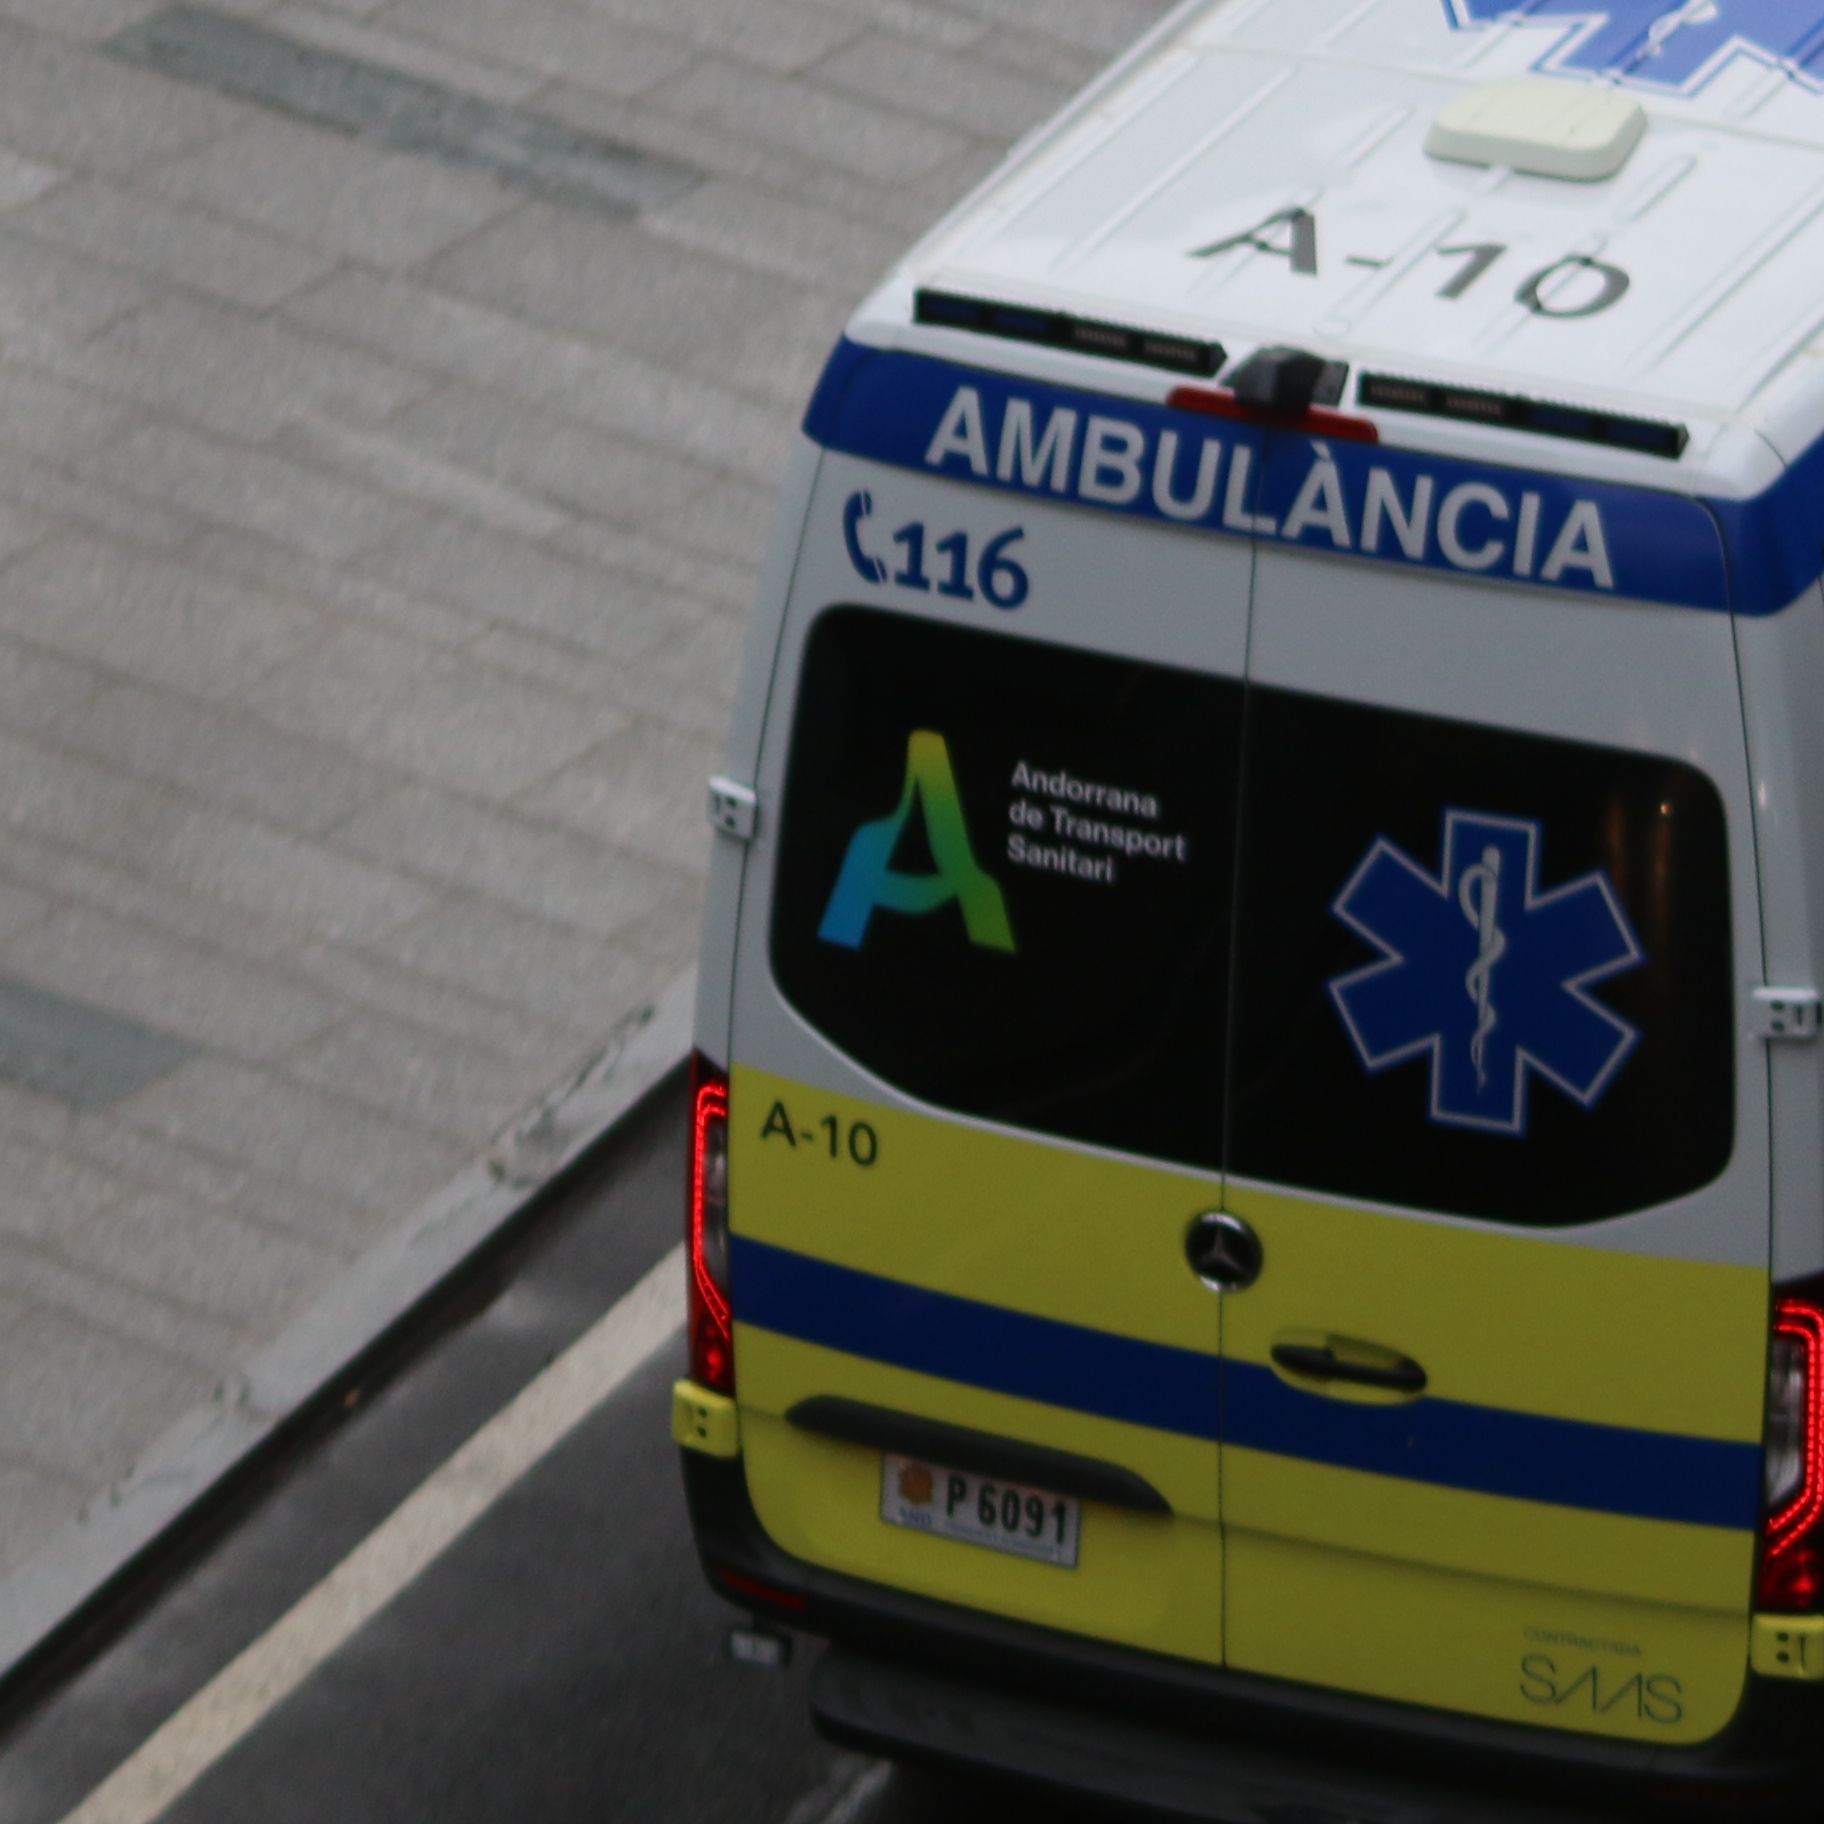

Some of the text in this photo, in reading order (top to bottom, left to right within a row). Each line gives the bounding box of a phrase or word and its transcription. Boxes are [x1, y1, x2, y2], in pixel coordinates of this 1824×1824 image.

[1185, 206, 1631, 319] A-10
[925, 385, 1616, 590] AMBULÀNCIA
[891, 520, 1031, 610] 116
[1011, 760, 1159, 819] Andorrana
[1007, 834, 1115, 884] Sanitari
[1009, 798, 1187, 863] de Transport
[759, 1101, 879, 1167] A-10
[947, 1475, 966, 1517] P
[977, 1483, 1066, 1544] 6091
